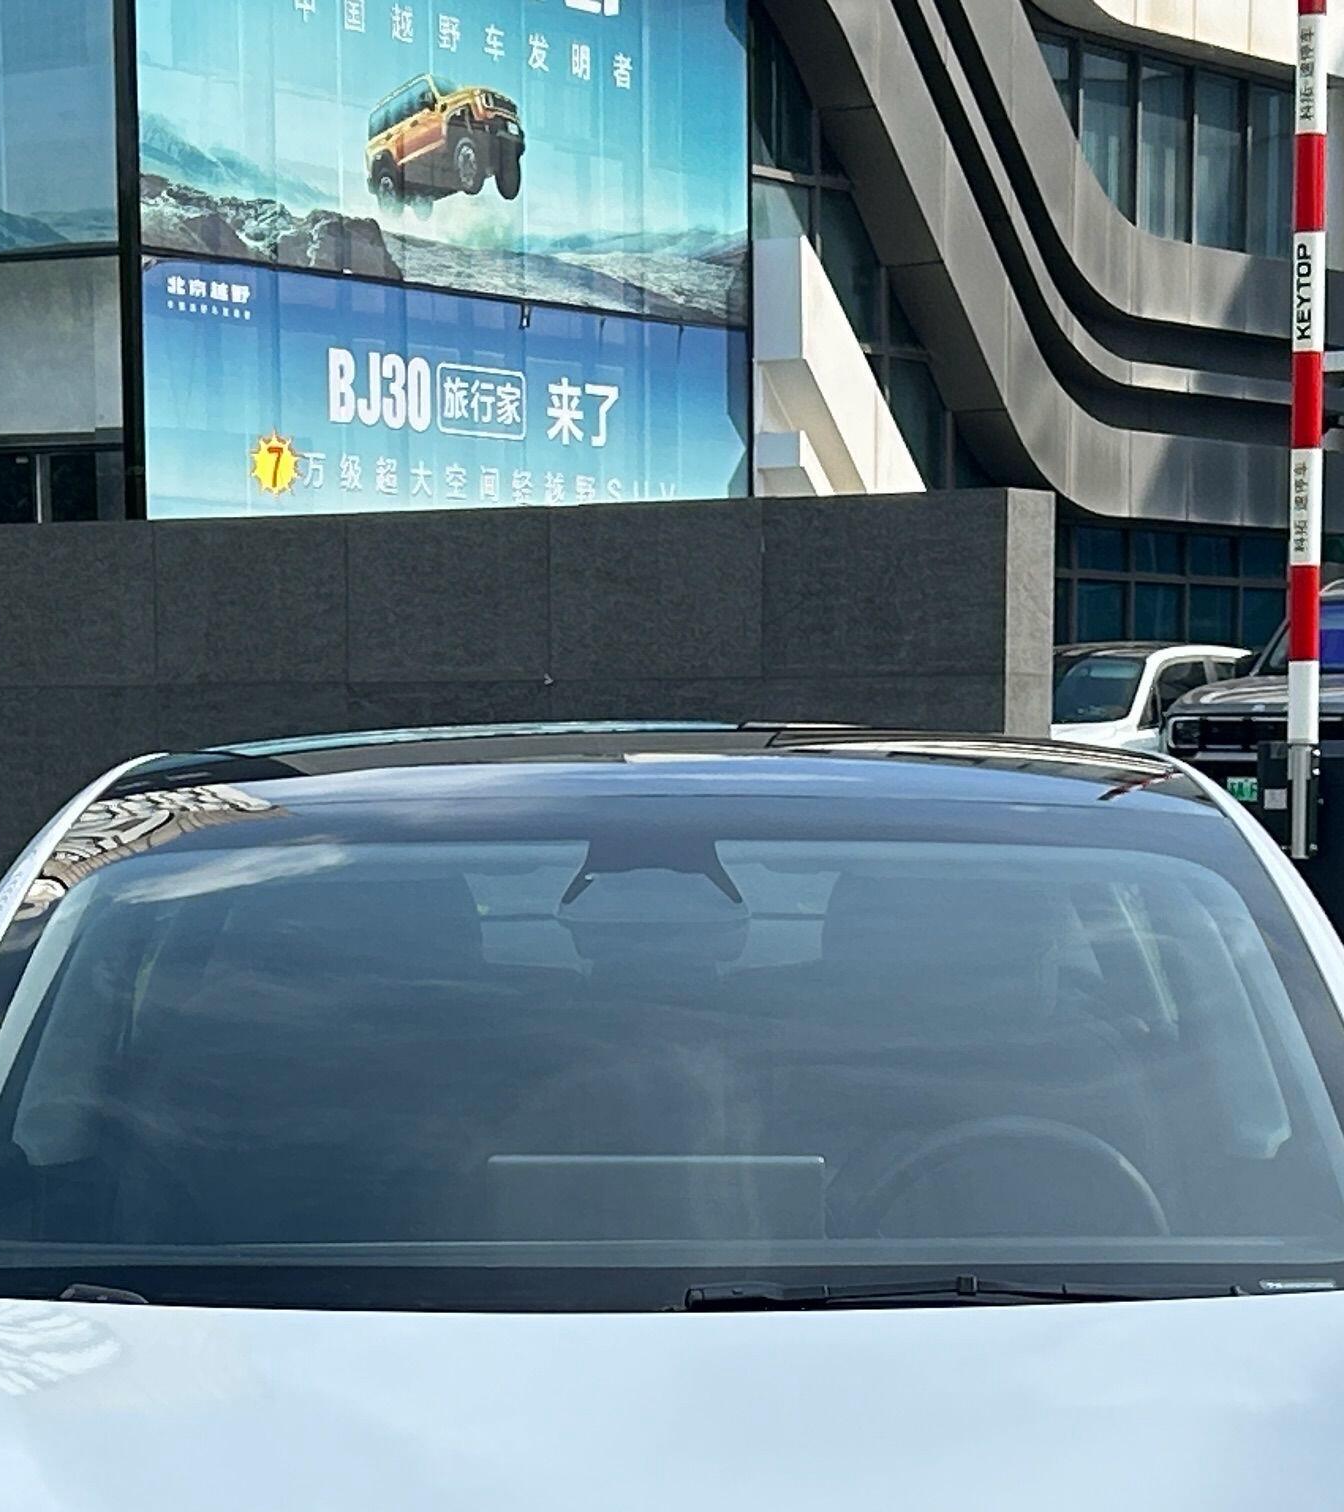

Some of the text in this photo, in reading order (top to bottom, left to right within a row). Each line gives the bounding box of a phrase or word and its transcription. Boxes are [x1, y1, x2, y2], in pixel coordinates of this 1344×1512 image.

[1296, 243, 1312, 340] KEYTOP
[328, 347, 619, 447] BJ30 旅行家 来了
